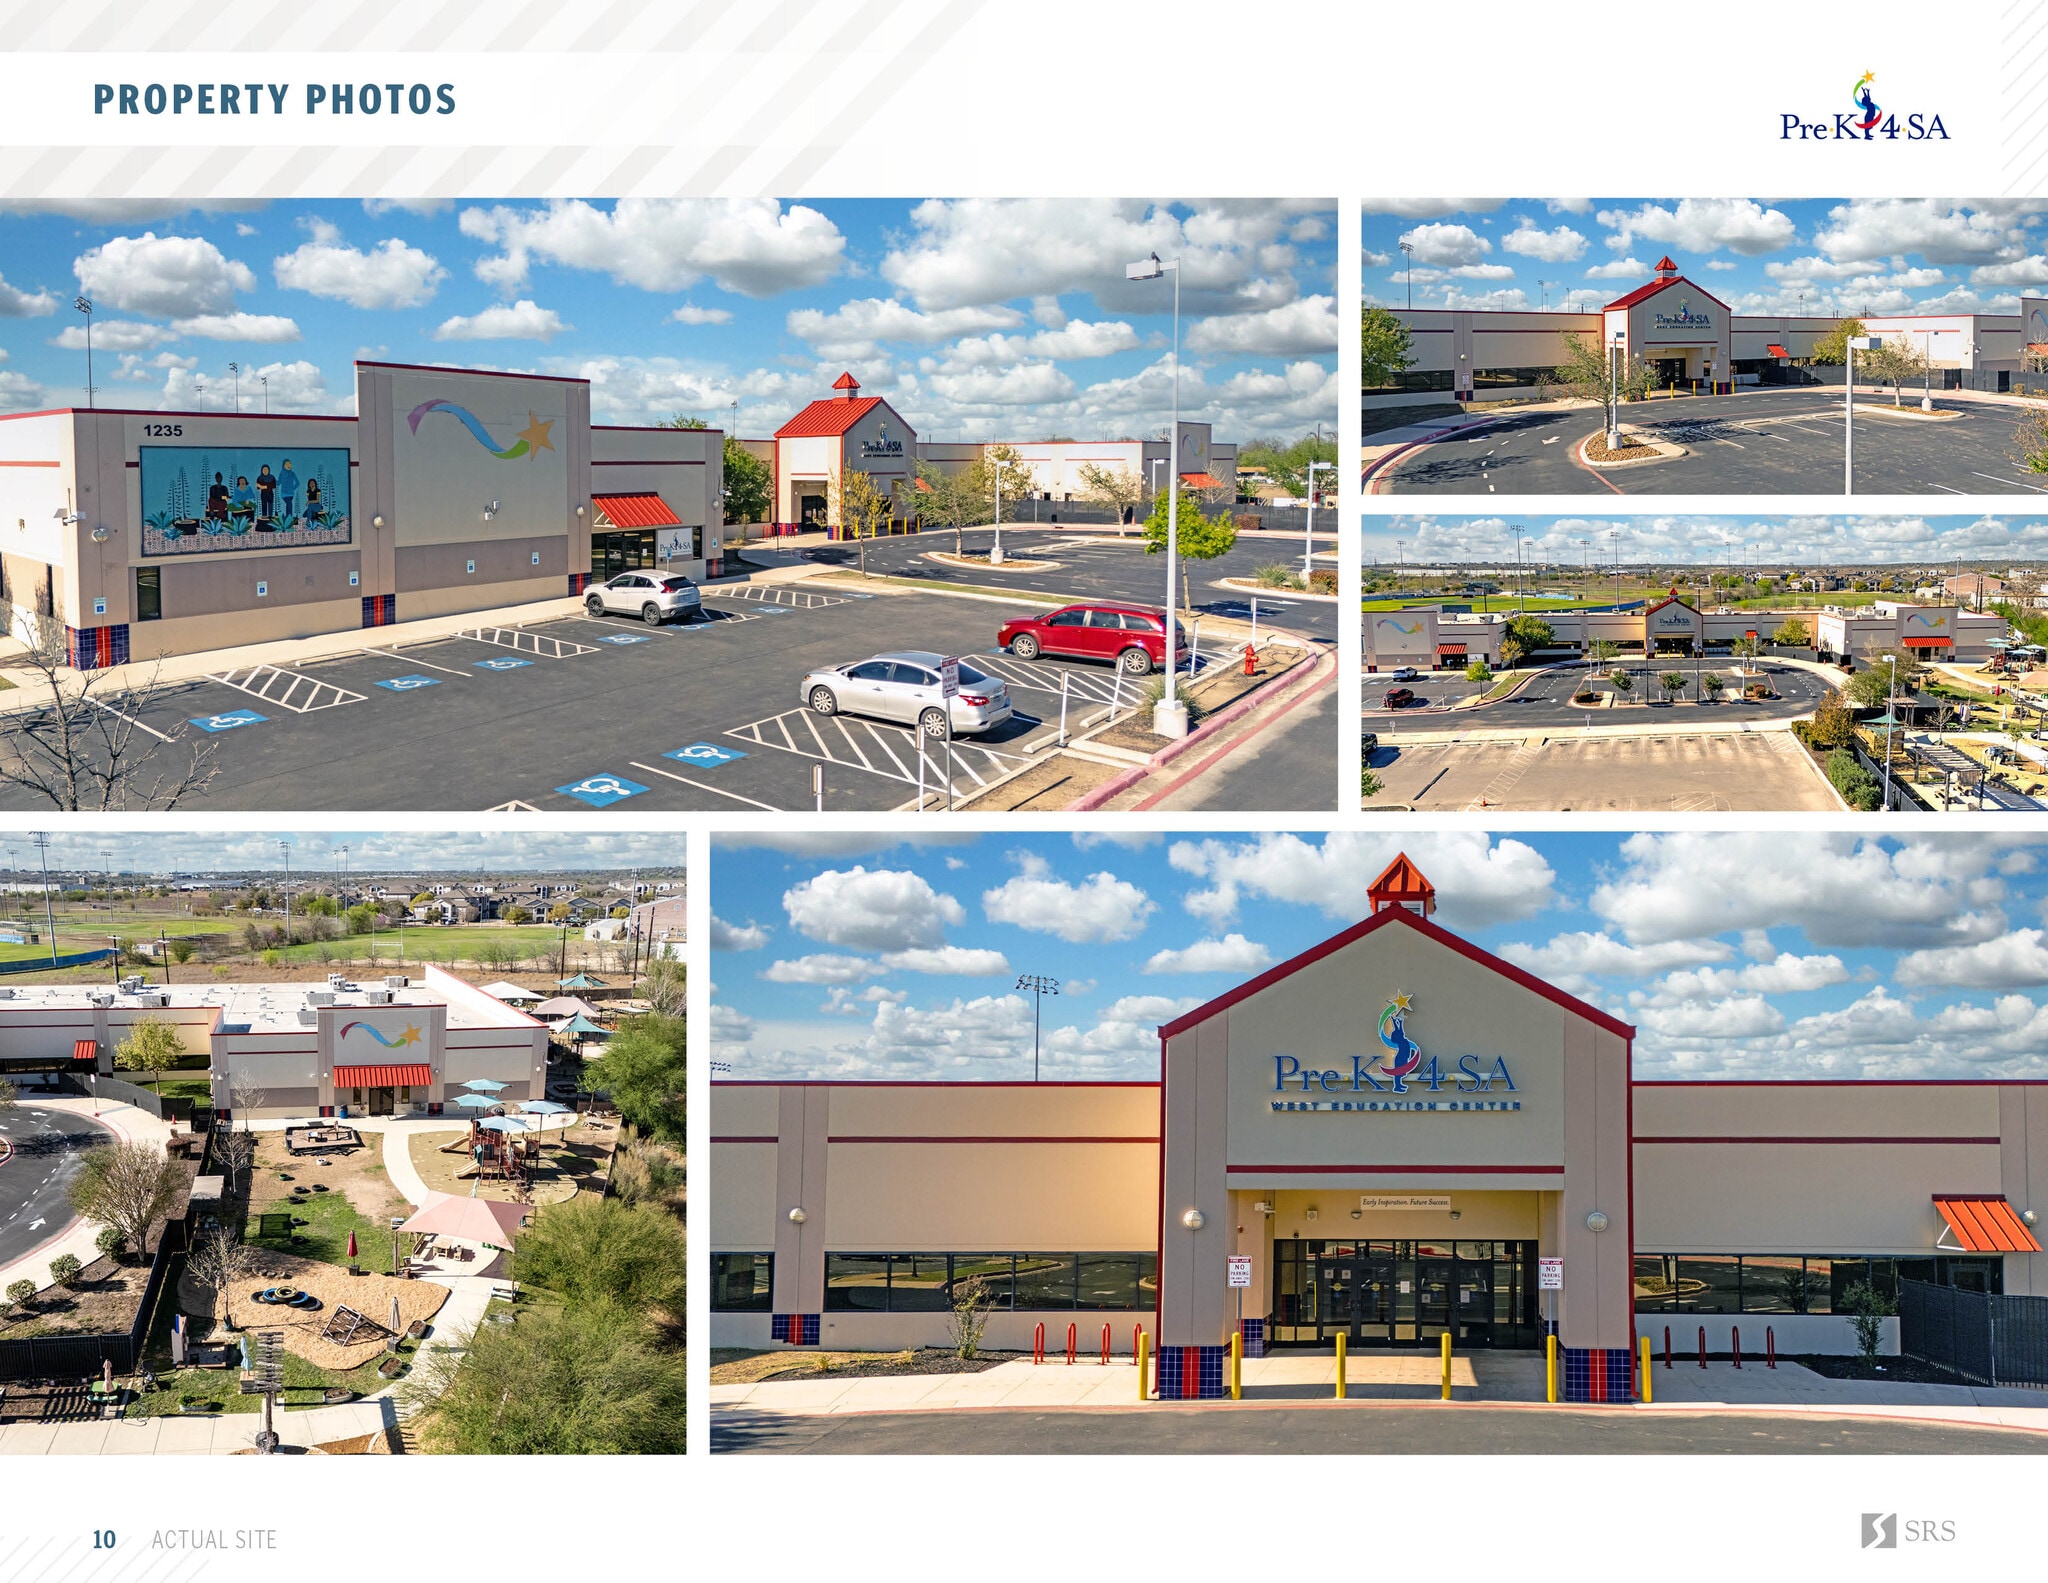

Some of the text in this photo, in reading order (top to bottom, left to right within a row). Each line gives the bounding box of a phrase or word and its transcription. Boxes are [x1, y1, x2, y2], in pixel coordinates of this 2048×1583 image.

[143, 424, 183, 437] 1235
[1271, 1101, 1521, 1112] WEST EDUCATION CENTER
[1362, 1198, 1449, 1208] Early Inspiration. Future Success.
